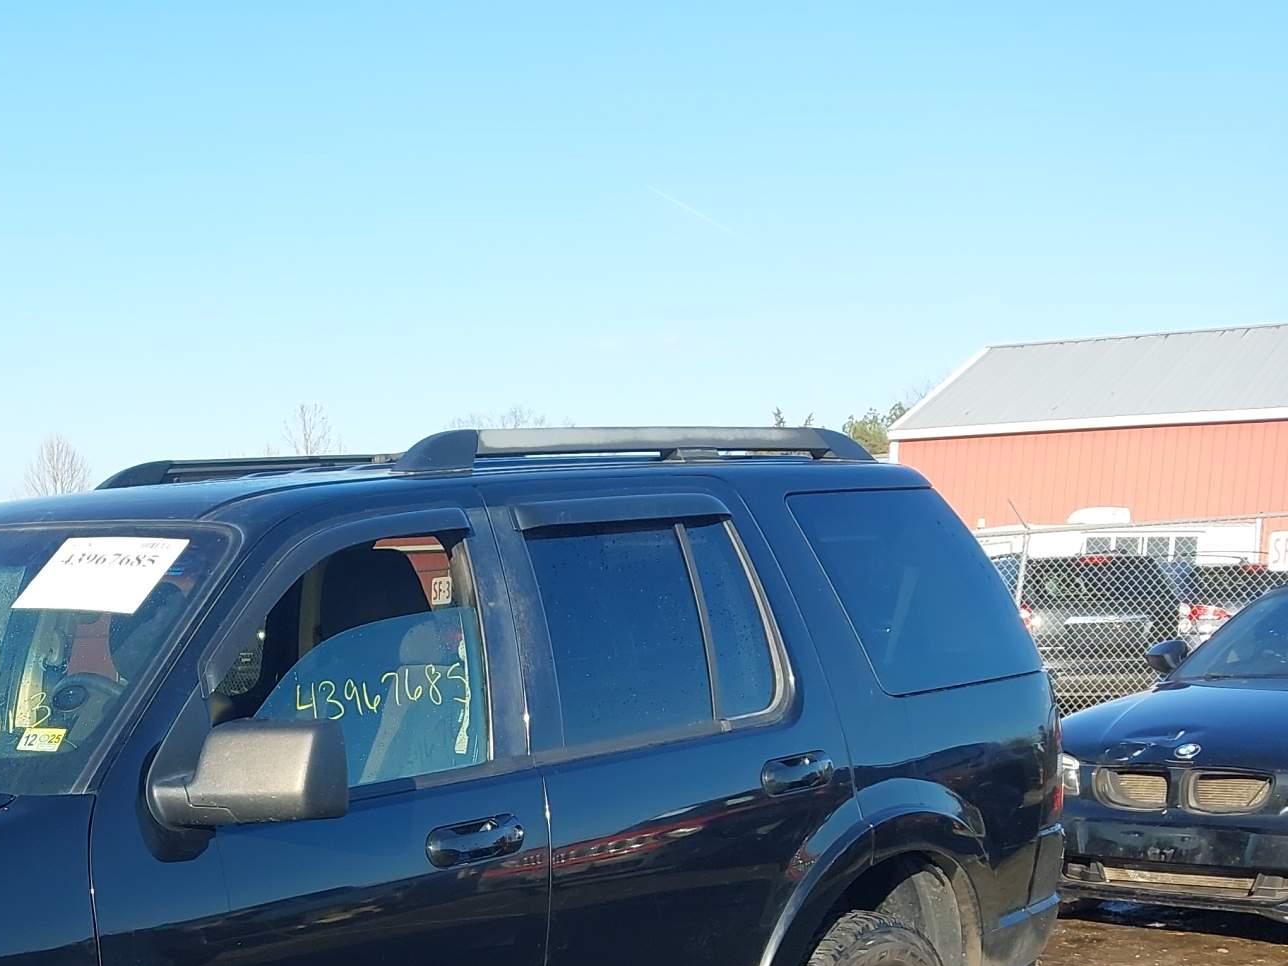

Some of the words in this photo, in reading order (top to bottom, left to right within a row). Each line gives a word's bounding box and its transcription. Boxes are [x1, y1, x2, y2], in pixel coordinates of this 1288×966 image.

[296, 661, 471, 720] 43967685
[23, 733, 38, 746] 12
[48, 733, 62, 744] 25
